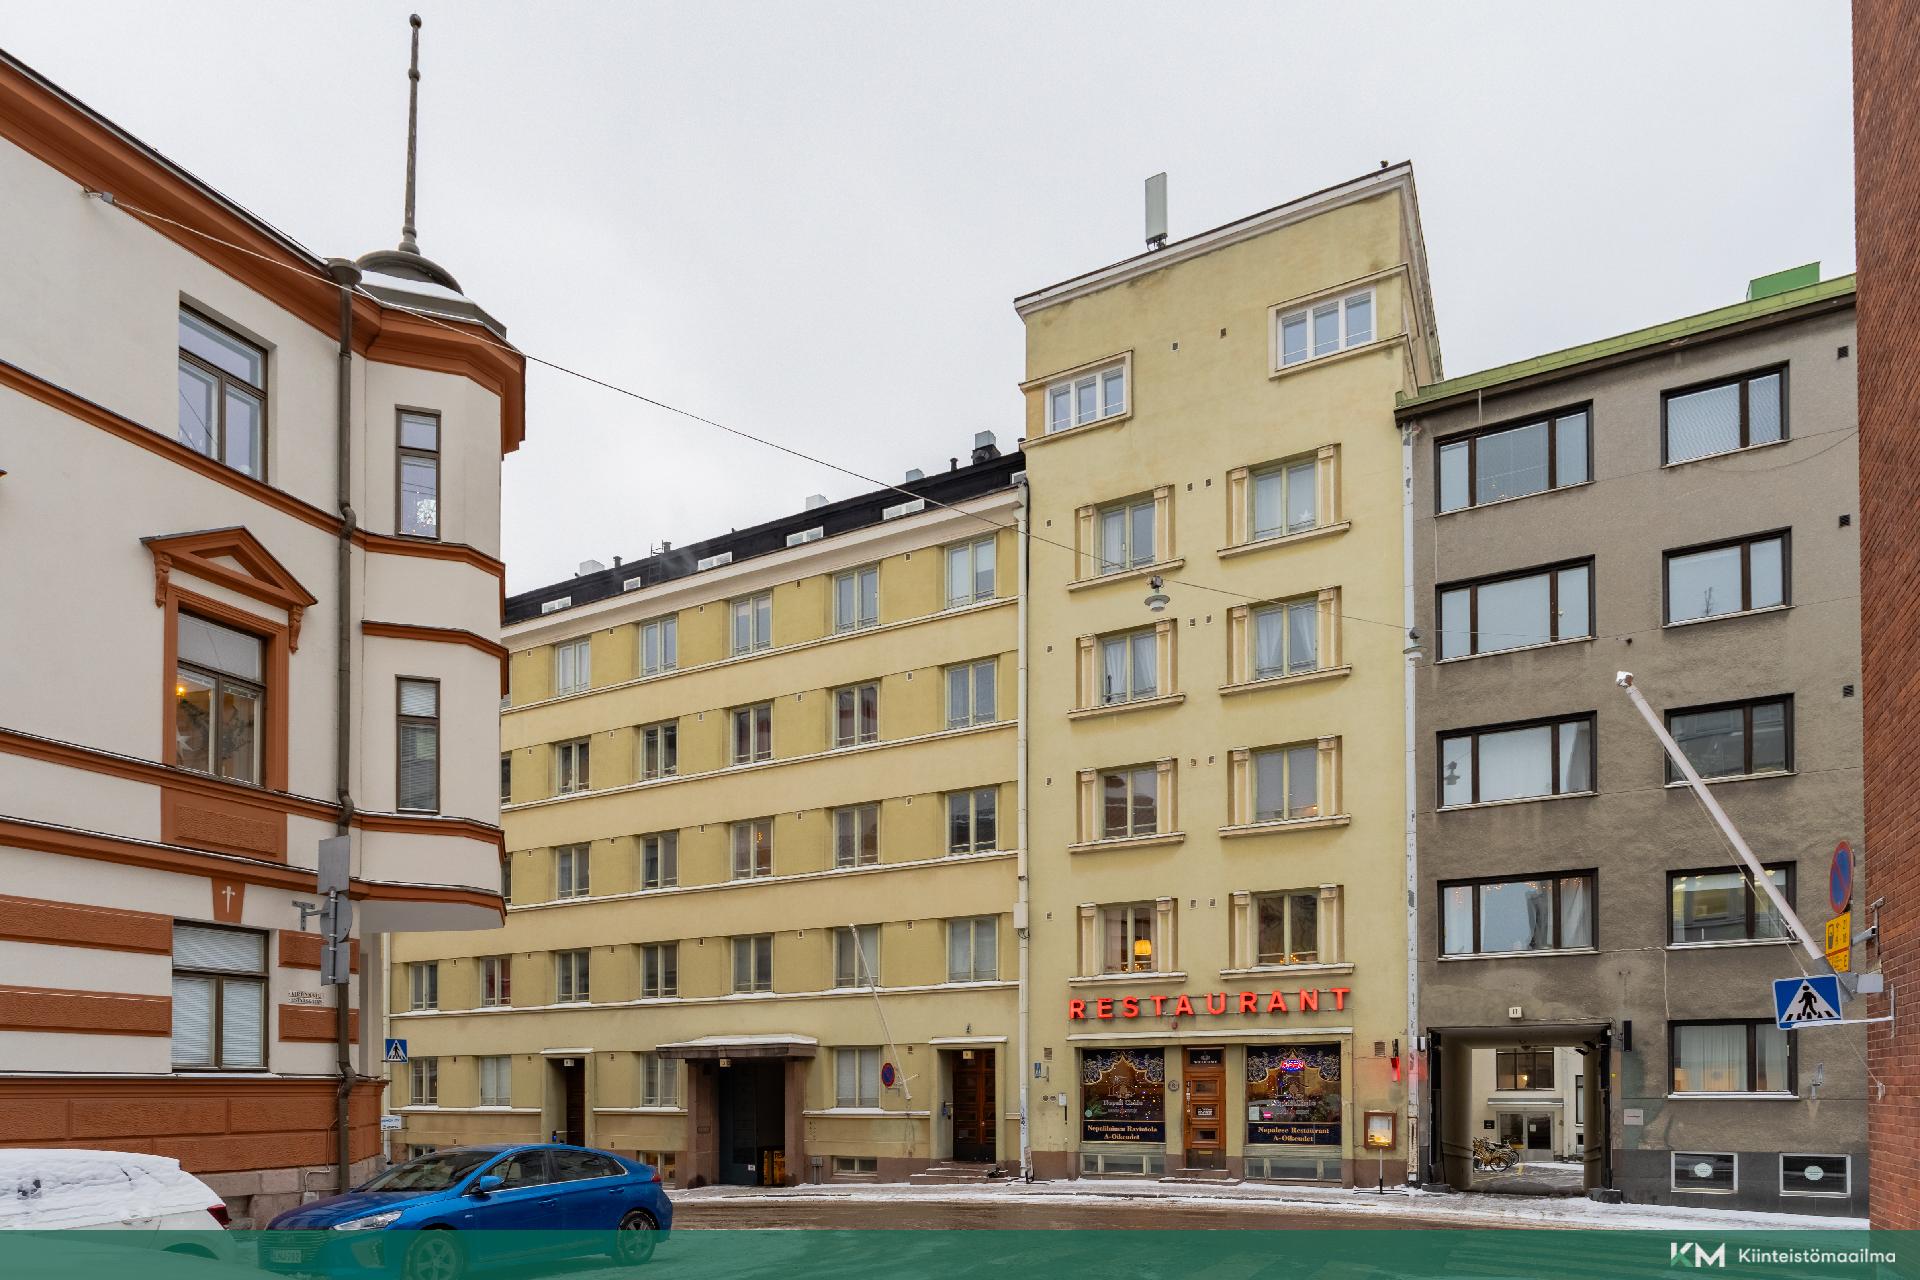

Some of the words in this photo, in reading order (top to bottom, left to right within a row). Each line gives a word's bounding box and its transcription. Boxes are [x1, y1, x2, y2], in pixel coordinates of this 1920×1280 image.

[1069, 988, 1350, 1020] RESTAURANT
[1281, 1061, 1304, 1069] OPEN
[1258, 1126, 1289, 1134] Nepalese
